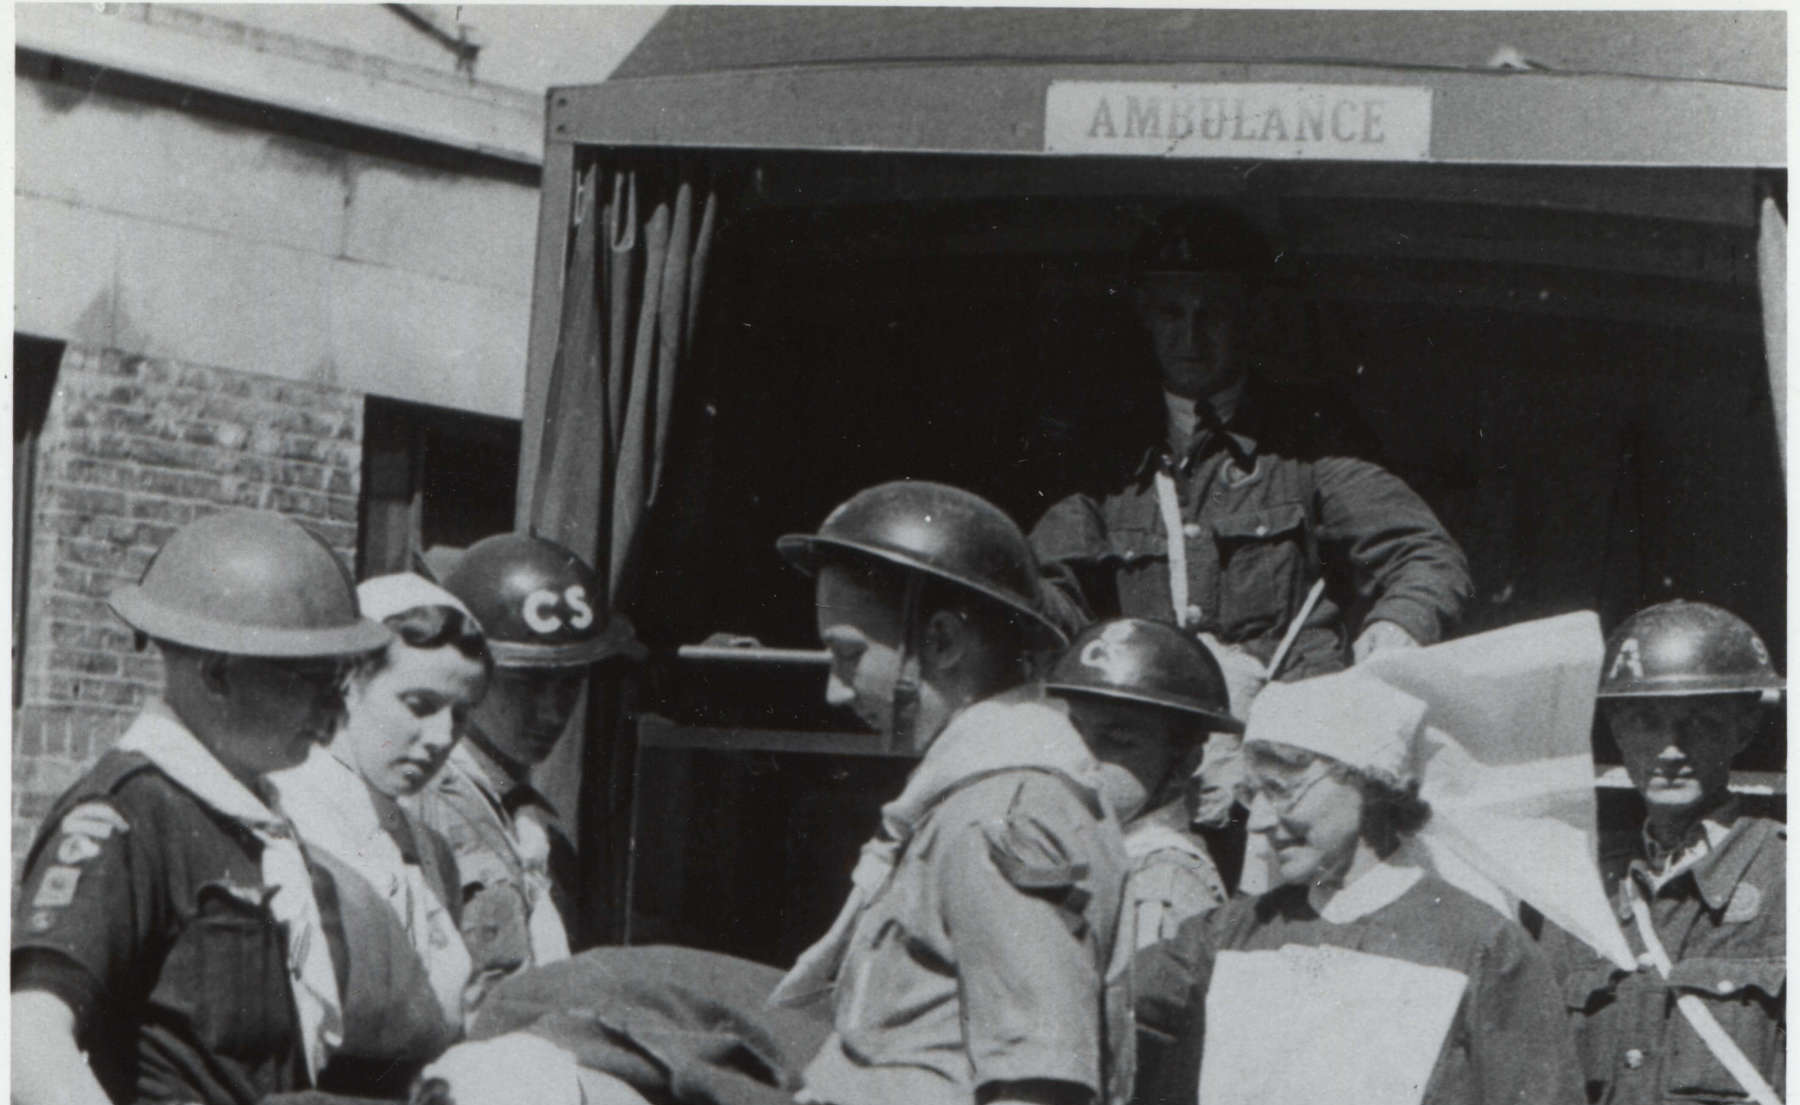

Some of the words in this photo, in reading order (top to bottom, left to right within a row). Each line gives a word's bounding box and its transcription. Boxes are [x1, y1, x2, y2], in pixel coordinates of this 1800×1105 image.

[1087, 97, 1386, 144] AMBULANCE
[523, 585, 593, 634] CS
[1608, 637, 1644, 680] A
